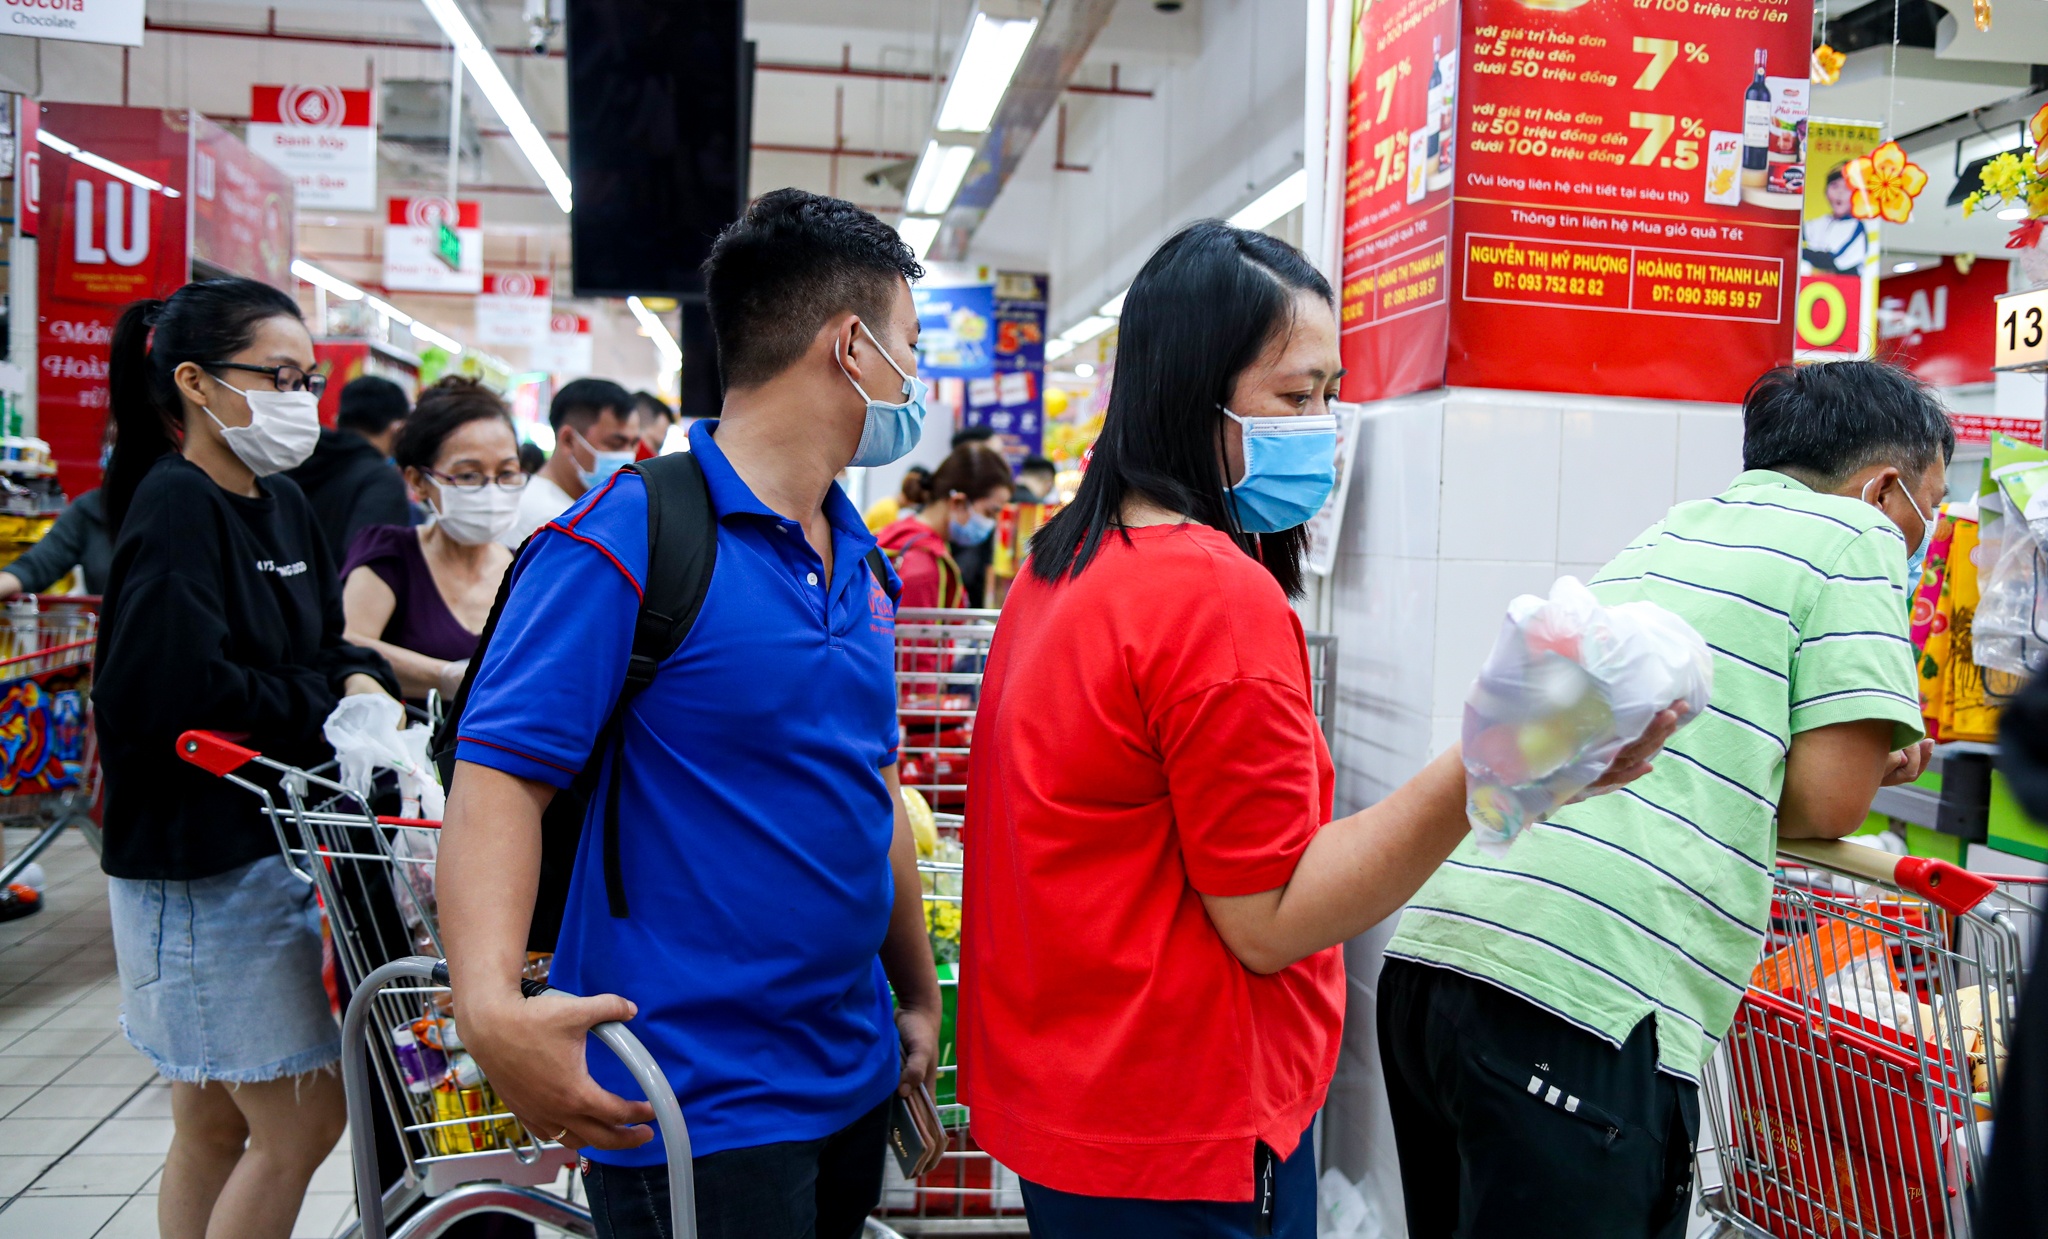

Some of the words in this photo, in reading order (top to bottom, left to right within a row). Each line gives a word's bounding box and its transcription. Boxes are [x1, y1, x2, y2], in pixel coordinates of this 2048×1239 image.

[12, 11, 77, 29] Chocolate
[1694, 2, 1731, 19] triệu
[1735, 6, 1760, 21] trở
[1763, 9, 1789, 23] lên
[1475, 25, 1499, 38] với
[1500, 27, 1524, 41] giá
[1527, 30, 1546, 44] trị
[1547, 28, 1575, 44] hóa
[1578, 34, 1607, 48] đơn
[1474, 42, 1492, 55] từ
[1493, 41, 1508, 57] 5
[1510, 46, 1545, 61] triệu
[1548, 49, 1576, 63] đến
[1473, 61, 1507, 75] dưới
[1509, 60, 1540, 78] 50
[1542, 67, 1576, 83] triệu
[1579, 70, 1618, 88] đồng
[1471, 102, 1496, 116] với
[1497, 105, 1521, 120] giá
[1524, 107, 1542, 122] trị
[1544, 109, 1572, 123] hóa
[1575, 112, 1604, 126] đơn
[1471, 120, 1489, 134] từ
[1489, 118, 1520, 137] 50
[1522, 125, 1558, 140] triệu
[1560, 128, 1598, 146] đồng
[1601, 131, 1629, 146] đến
[1470, 139, 1505, 154] dưới
[1508, 138, 1548, 157] 100
[1551, 145, 1585, 162] triệu
[1588, 148, 1626, 166] đồng
[1467, 172, 1495, 187] (Vui
[1496, 174, 1526, 192] lòng
[1528, 177, 1551, 191] liên
[1554, 180, 1571, 194] hệ
[1573, 181, 1593, 194] chi
[1596, 182, 1618, 197] tiết
[1620, 185, 1637, 200] tại
[1640, 187, 1665, 201] siêu
[1668, 190, 1690, 204] thị)
[75, 180, 149, 266] LU
[1511, 209, 1556, 228] Thông
[1560, 213, 1579, 228] tin
[1582, 215, 1608, 230] liên
[1611, 218, 1629, 233] hệ
[1632, 220, 1662, 235] Mua
[1665, 222, 1687, 238] giỏ
[1690, 224, 1717, 240] quà
[1720, 226, 1743, 241] Tết
[1470, 241, 1525, 267] NGUYỄN
[1527, 250, 1549, 272] THỊ
[1573, 254, 1629, 276] PHƯỢNG
[1637, 257, 1683, 280] HOÀNG
[1685, 263, 1706, 285] THỊ
[1709, 265, 1751, 285] THANH
[1754, 269, 1779, 287] LAN
[1493, 271, 1515, 289] ĐT:
[1517, 273, 1542, 291] 093
[1545, 275, 1567, 294] 752
[1569, 277, 1586, 296] 82
[1588, 278, 1605, 297] 82
[1652, 284, 1674, 303] ĐT:
[1676, 286, 1702, 305] 090
[1703, 288, 1727, 307] 396
[1729, 290, 1746, 308] 59
[1747, 291, 1763, 309] 57
[2003, 307, 2043, 350] 13
